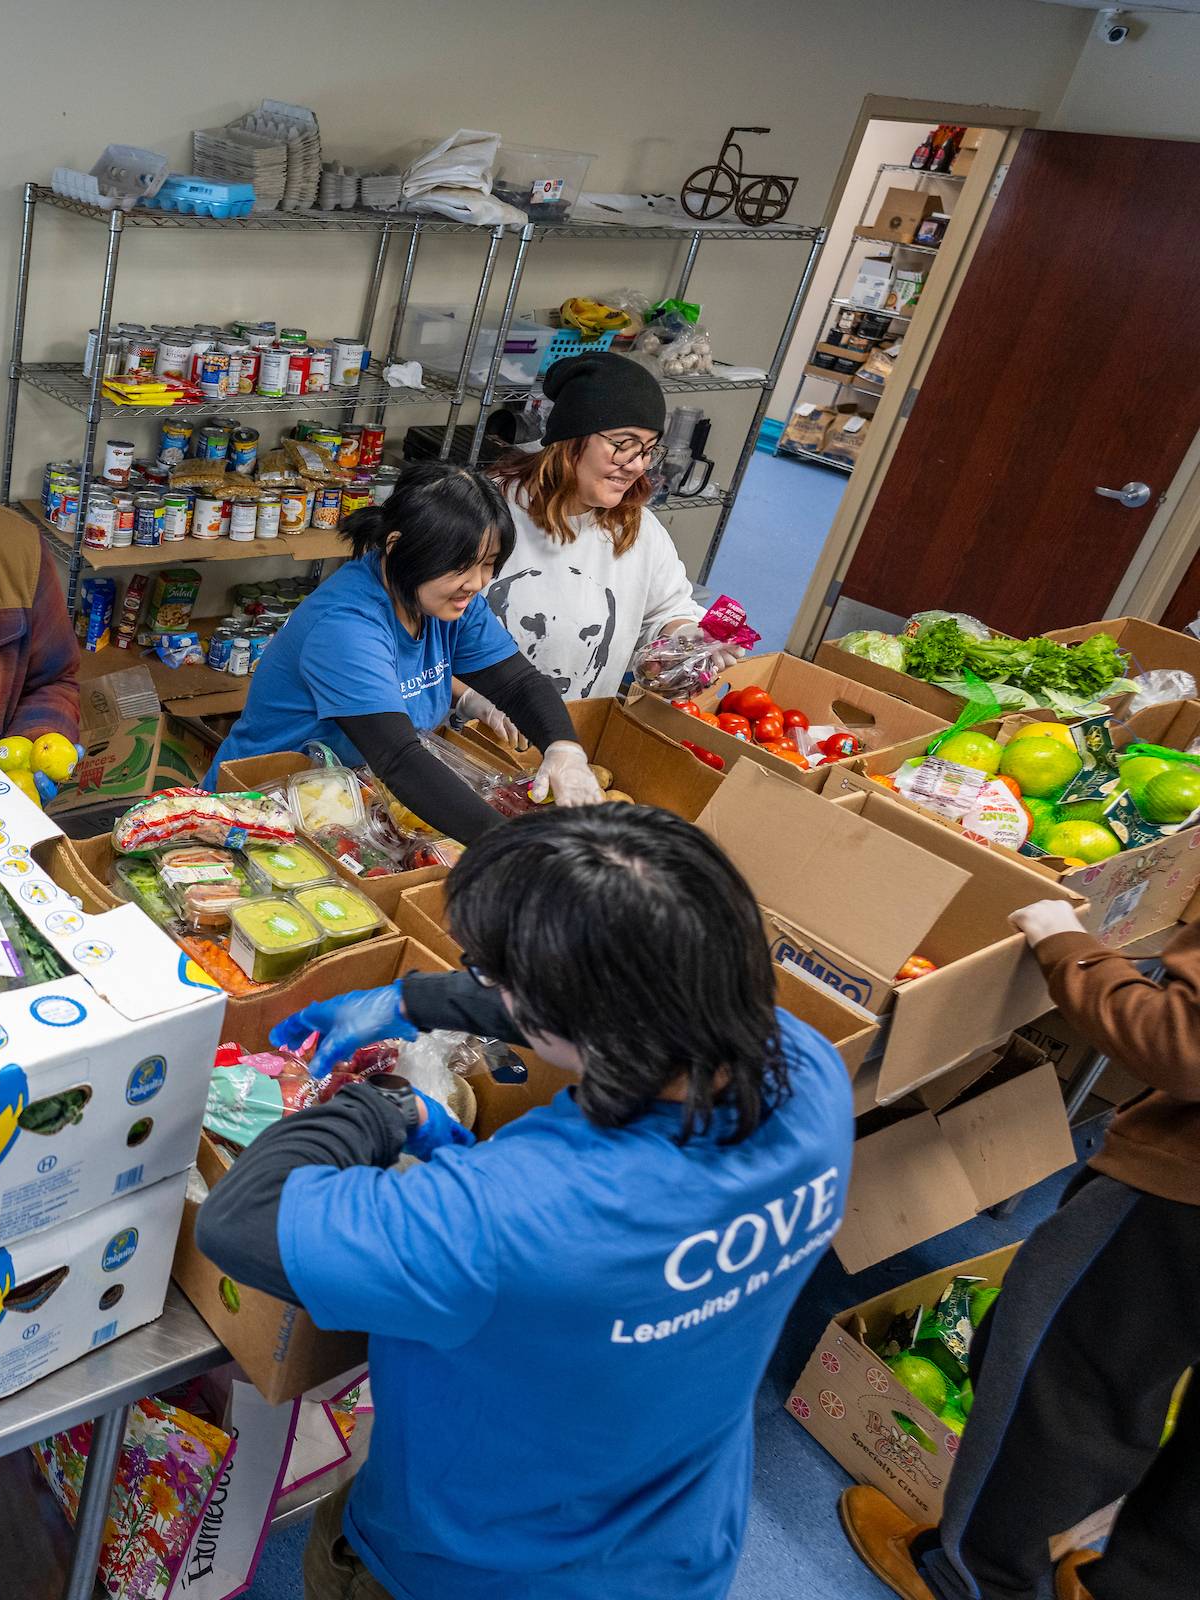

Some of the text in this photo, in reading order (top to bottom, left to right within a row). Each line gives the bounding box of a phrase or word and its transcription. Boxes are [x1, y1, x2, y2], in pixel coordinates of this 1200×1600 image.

[127, 1076, 165, 1099] Chiquita
[103, 1246, 137, 1267] Chiquita
[663, 1166, 839, 1292] COVE
[610, 1285, 741, 1344] Learning
[745, 1269, 770, 1297] in
[850, 1432, 897, 1480] Specialty
[897, 1479, 929, 1512] Citrus
